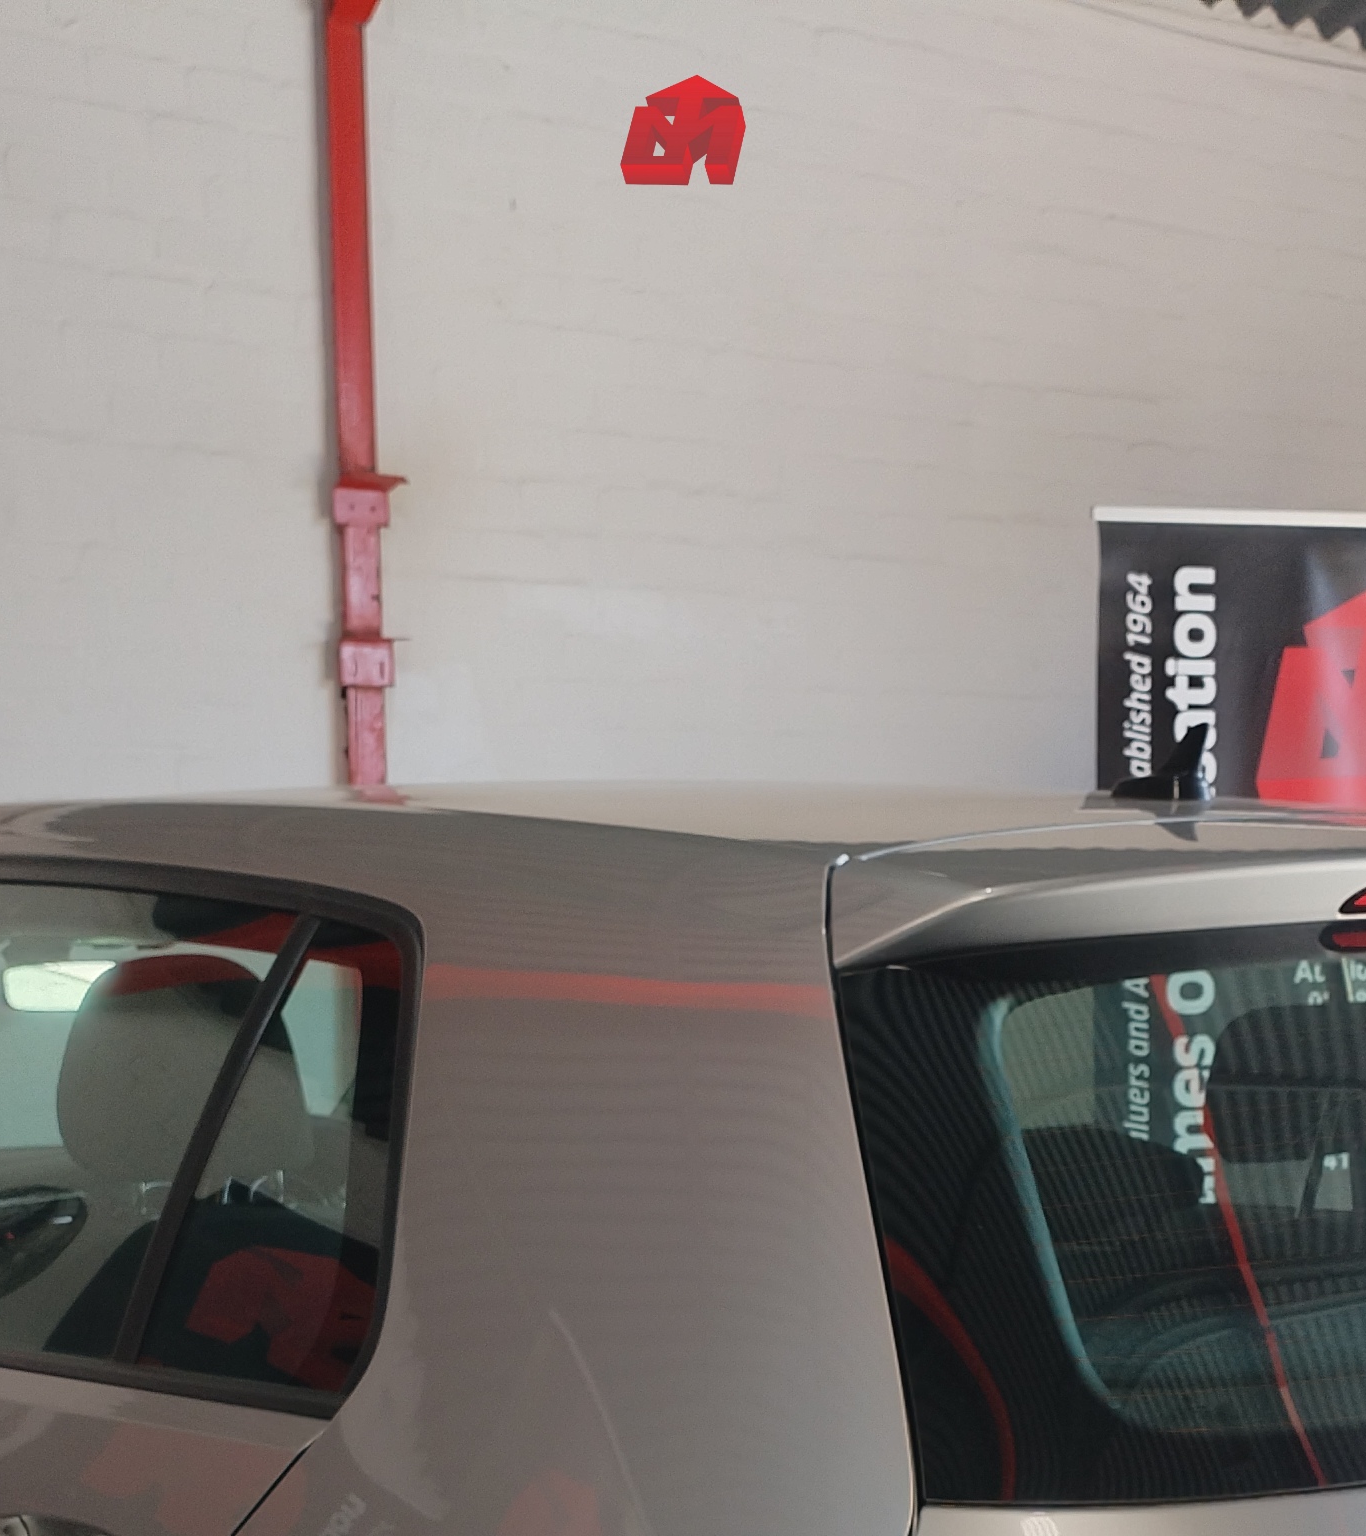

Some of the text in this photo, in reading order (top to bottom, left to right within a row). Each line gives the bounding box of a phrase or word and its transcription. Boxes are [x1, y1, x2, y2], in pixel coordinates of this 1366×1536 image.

[1123, 572, 1153, 778] ablished 1964
[1121, 1002, 1150, 1058] and
